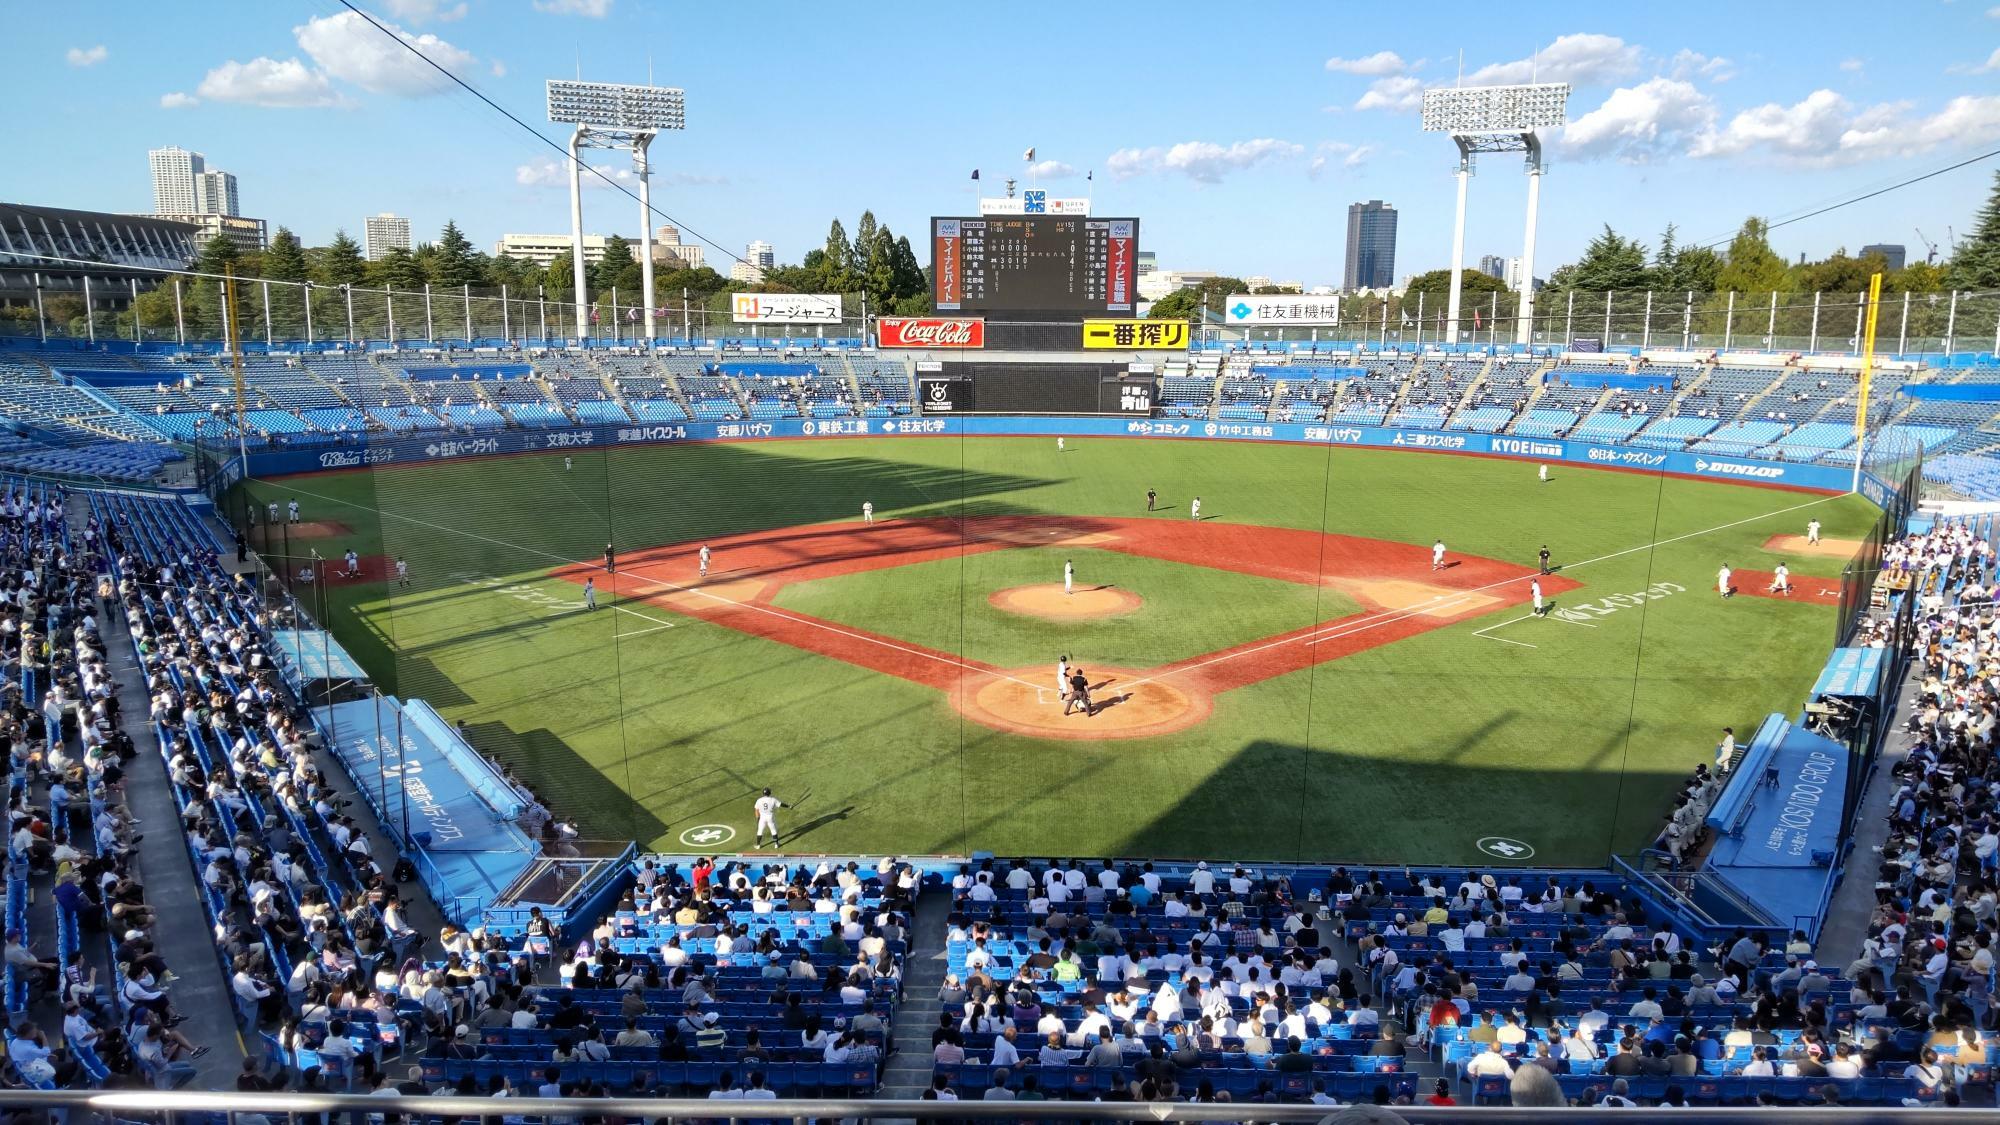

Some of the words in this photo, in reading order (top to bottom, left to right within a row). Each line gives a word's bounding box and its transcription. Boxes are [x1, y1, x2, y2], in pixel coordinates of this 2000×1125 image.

[943, 238, 954, 302] マイナビバイト
[1113, 238, 1126, 303] マイナビ転職
[763, 305, 836, 319] フージャース
[1257, 304, 1335, 319] 住友重機械
[899, 320, 975, 344] Coca-Cola
[1090, 323, 1183, 346] 一番搾り
[1120, 396, 1149, 410] 青山
[617, 426, 686, 441] 東進ハイスクール
[718, 424, 773, 437] 安藤ハザマ
[818, 421, 869, 433] 東鉄工業
[898, 420, 945, 433] 住友化学
[1219, 424, 1273, 437] 竹中工務店
[547, 431, 594, 447] 文教大学
[1303, 428, 1362, 442] 安藤ハザマ
[1406, 433, 1466, 448] 三菱ガス化学
[440, 437, 499, 456] 住友ベークライト
[1491, 438, 1535, 455] KYOEI
[1599, 449, 1667, 465] 日本ハウズイング
[1708, 462, 1784, 477] DUNLOP
[1799, 752, 1837, 785] GROUP
